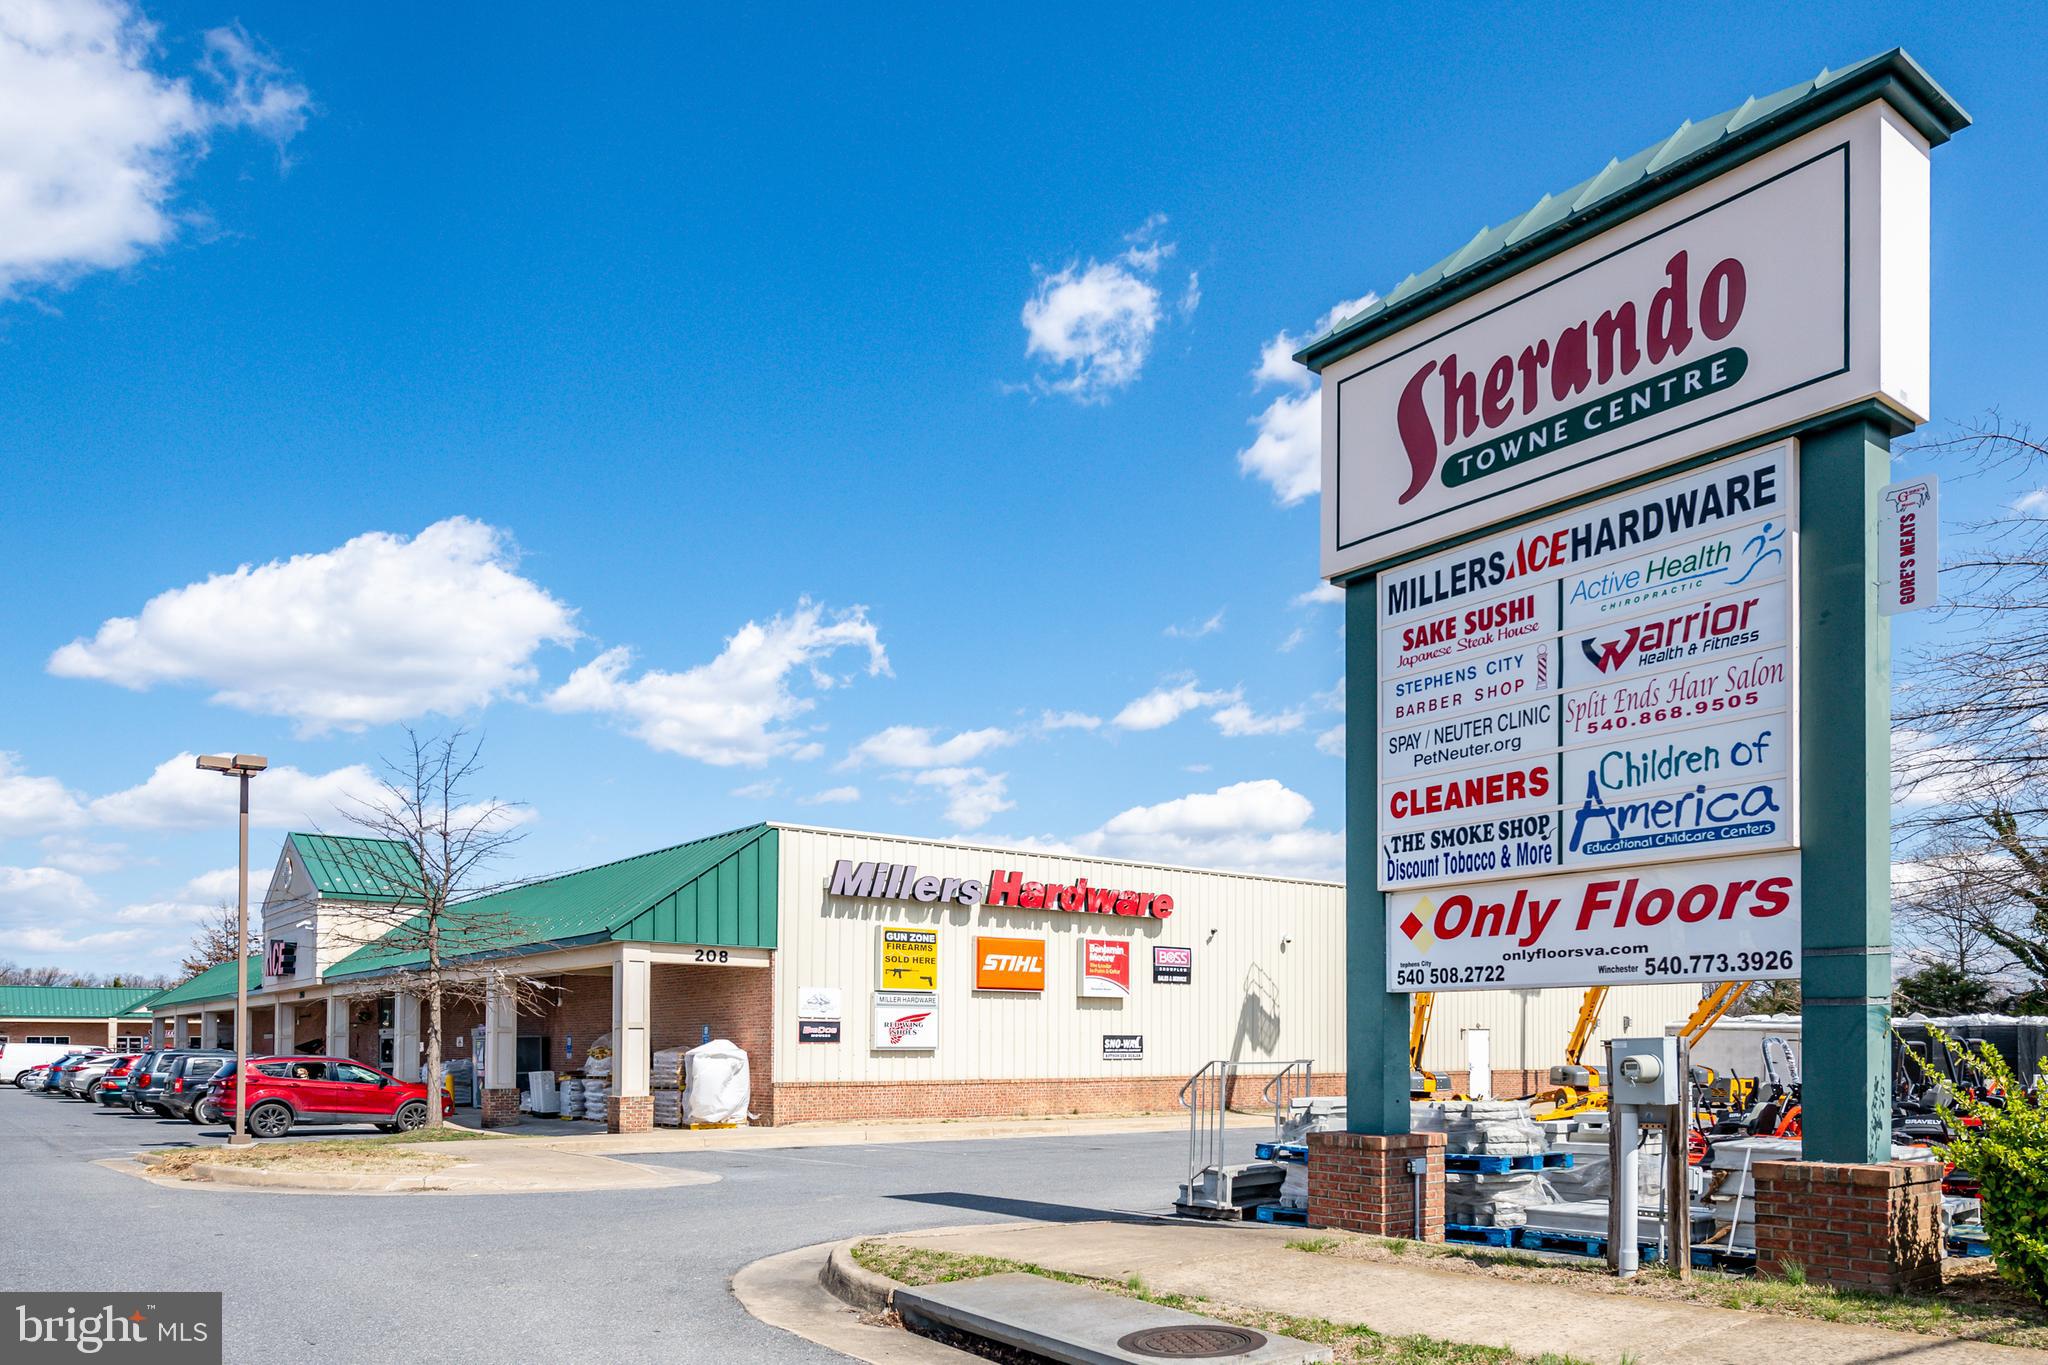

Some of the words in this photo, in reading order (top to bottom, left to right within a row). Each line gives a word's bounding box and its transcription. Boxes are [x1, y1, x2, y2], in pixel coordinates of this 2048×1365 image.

[1397, 249, 1747, 505] Sherando
[1457, 418, 1568, 477] TOWNE
[1583, 357, 1728, 430] CENTRE
[1388, 551, 1505, 616] MILLERS
[1505, 528, 1569, 580] ACE
[1571, 464, 1776, 562] HARDWARE
[1900, 513, 1915, 557] MEATS
[1570, 570, 1640, 605] Active
[1645, 541, 1731, 584] Health
[1900, 558, 1915, 605] GORE'S
[1600, 579, 1703, 612] CHIROPRACTIC
[1402, 616, 1457, 651] SAKE
[1464, 594, 1535, 635] SUSHI
[1581, 598, 1760, 674] Warrior
[1397, 645, 1452, 668] Japanese
[1456, 632, 1494, 652] Steak
[1497, 622, 1540, 641] House
[1638, 644, 1683, 667] Health
[1687, 640, 1698, 655] &
[1703, 629, 1760, 653] Fitness
[1396, 666, 1477, 697] STEPHENS
[1486, 654, 1524, 675] CITY
[1565, 690, 1607, 732] Split
[1614, 678, 1660, 714] Ends
[1666, 671, 1719, 704] Hair
[1725, 656, 1785, 693] Salon
[1396, 693, 1462, 719] BARBER
[1475, 679, 1525, 701] SHOP
[1587, 691, 1759, 734] 540.868.9505
[1389, 732, 1422, 754] SPAY
[1434, 717, 1493, 745] NEUTER
[1497, 704, 1551, 732] CLINIC
[1414, 737, 1522, 767] PetNeuter.org
[1600, 745, 1720, 790] Children
[1730, 730, 1772, 767] of
[1390, 766, 1549, 819] CLEANERS
[1568, 770, 1780, 852] America
[1391, 832, 1426, 854] THE
[1430, 823, 1495, 849] SMOKE
[1498, 814, 1551, 841] SHOP
[1586, 836, 1652, 854] Educational
[1656, 829, 1715, 846] Childcare
[1720, 823, 1772, 839] Centers
[1387, 855, 1439, 882] Discount
[1443, 851, 1496, 875] Tobacco
[1501, 844, 1511, 868] &
[1516, 842, 1552, 867] More
[830, 859, 982, 905] Millers
[986, 869, 1174, 919] Hardware
[1433, 889, 1562, 948] Only
[1575, 877, 1793, 931] Floors
[695, 949, 728, 963] 208
[886, 932, 909, 942] GUN
[909, 933, 936, 943] ZONE
[886, 943, 933, 952] FIREARMS
[1159, 951, 1188, 963] BOSS
[1502, 944, 1649, 962] onlyfloorsva.com
[885, 955, 909, 963] SOLD
[912, 956, 936, 965] HERE
[982, 954, 1043, 973] STIHL
[1397, 969, 1425, 986] 540
[1430, 965, 1505, 984] 508.2722
[1421, 960, 1432, 968] City
[1598, 964, 1639, 974] Winchester
[1644, 950, 1793, 976] 540.773.3926
